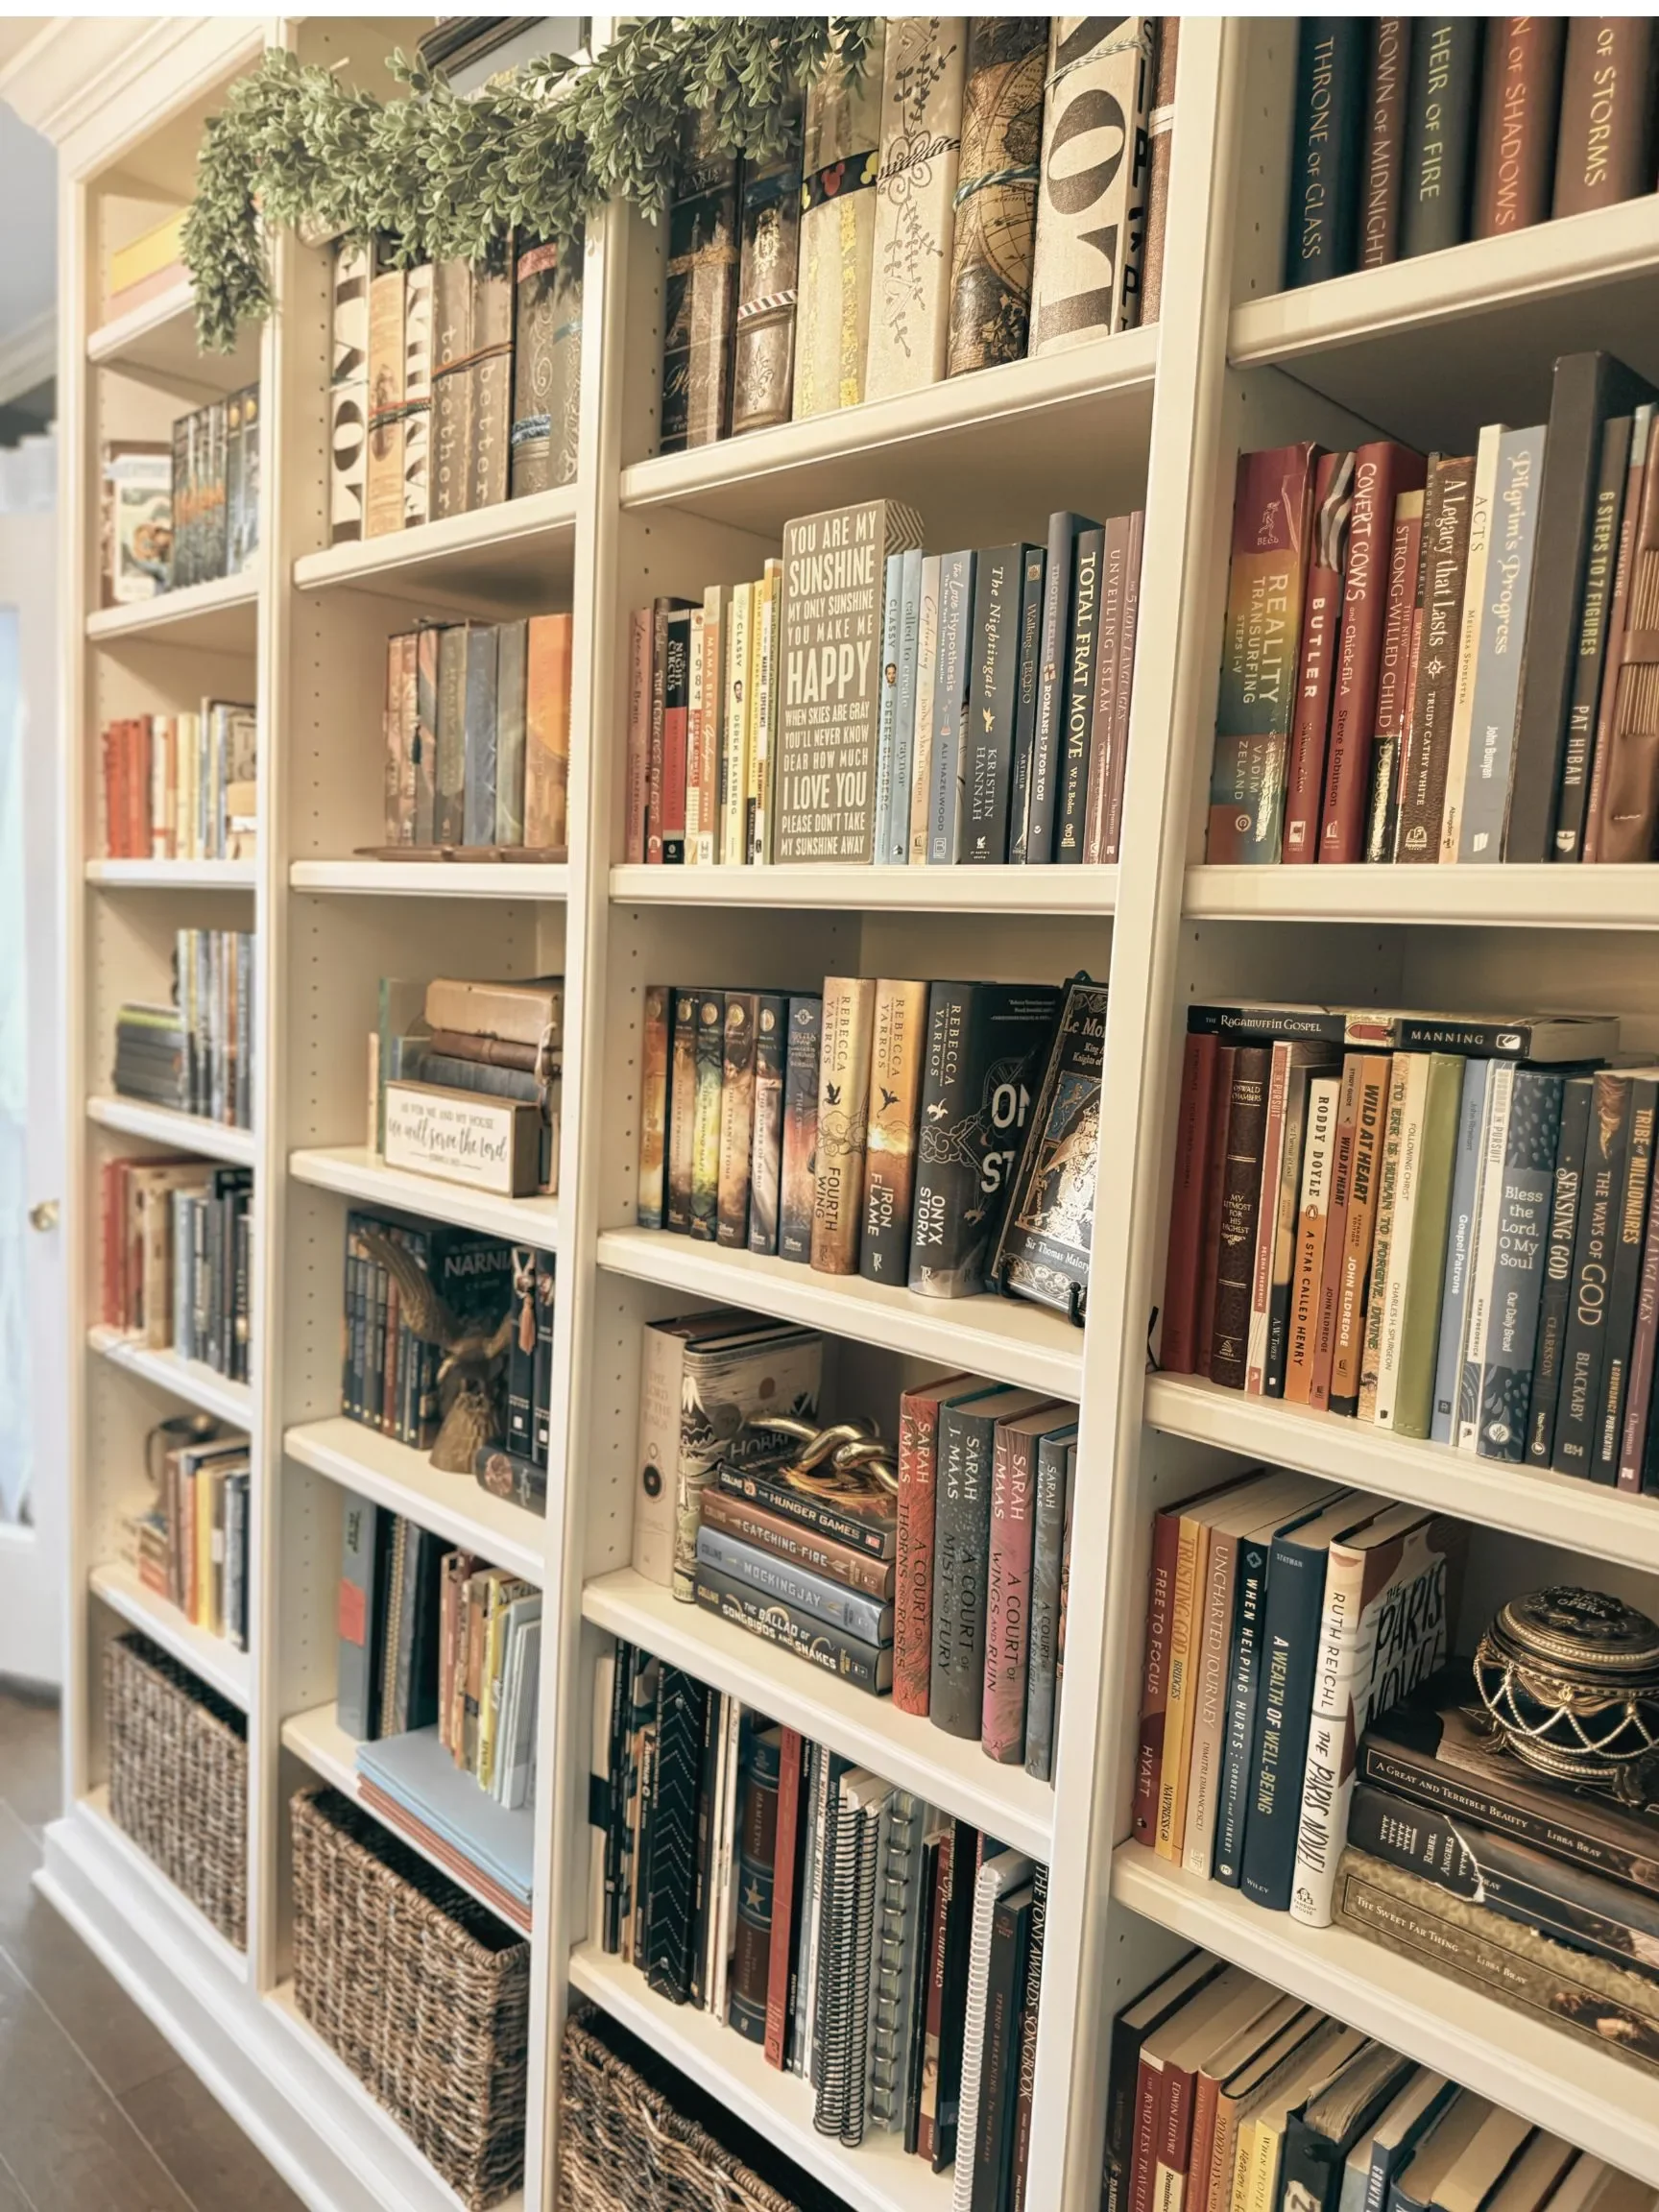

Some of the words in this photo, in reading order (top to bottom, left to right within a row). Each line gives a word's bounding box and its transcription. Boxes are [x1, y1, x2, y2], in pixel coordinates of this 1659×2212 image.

[1428, 27, 1451, 93] HEIR
[1307, 36, 1334, 143] THRONE
[1496, 84, 1527, 226] SHADOWS
[1584, 70, 1616, 187] STORMS
[1420, 145, 1443, 202] FIRE
[1303, 185, 1324, 259] GLASS
[1365, 139, 1390, 265] MIDNIGHT
[1350, 462, 1377, 540] COVERT
[1433, 497, 1466, 554] Legacy
[1472, 495, 1487, 552] ACTS
[791, 523, 815, 555] YOU
[823, 517, 849, 548] ARE
[856, 511, 877, 541] MY
[1593, 505, 1614, 553] STEPS
[789, 545, 875, 597] SUNSHINE
[991, 566, 1003, 597] The
[1076, 552, 1095, 626] TOTAL
[1345, 542, 1367, 601] COWS
[1590, 558, 1607, 575] TO
[787, 602, 801, 623] MY
[804, 597, 824, 618] ONLY
[829, 589, 874, 615] SUNSHINE
[1104, 550, 1120, 648] UNVEILING
[1381, 525, 1409, 669] STRONG-WILLED
[1581, 592, 1602, 655] FIGURES
[787, 625, 809, 645] YOU
[817, 618, 849, 640] MAKE
[857, 614, 873, 635] ME
[982, 604, 1001, 697] Nightingale
[1242, 576, 1265, 703] TRANSURFING
[1258, 573, 1288, 703] REALITY
[1303, 598, 1325, 699] BUTLER
[786, 640, 872, 706] HAPPY
[1073, 632, 1092, 686] FRAT
[785, 709, 806, 727] WHEN
[808, 707, 830, 724] SKIES
[831, 705, 847, 721] ARE
[849, 702, 870, 719] GRAY
[1041, 685, 1052, 735] ROMANS
[1069, 693, 1088, 759] MOVE
[1337, 709, 1348, 745] Steve
[1379, 673, 1396, 729] CHILD
[1426, 691, 1435, 728] TRUDY
[1571, 707, 1590, 732] PAT
[784, 730, 810, 750] YOU'LL
[814, 727, 839, 746] NEVER
[844, 725, 868, 744] KNOW
[784, 754, 808, 772] DEAR
[813, 751, 834, 769] HOW
[839, 749, 868, 766] MUCH
[1421, 731, 1431, 768] CATHY
[1565, 738, 1585, 784] HIBAN
[793, 775, 830, 809] LOVE
[836, 772, 866, 806] YOU
[973, 746, 984, 821] HANNAH
[985, 749, 997, 818] KRISTIN
[1235, 740, 1248, 800] ZELAND
[1250, 745, 1262, 792] VADIM
[1329, 748, 1343, 806] Robinson
[1417, 768, 1428, 805] WHITE
[781, 841, 793, 856] MY
[795, 838, 837, 854] SUNSHINE
[840, 836, 864, 854] AWAY
[782, 815, 811, 833] PLEASE
[815, 814, 841, 830] DON'T
[843, 812, 865, 830] TAKE
[824, 1000, 834, 1064] YARROS
[837, 997, 850, 1072] REBECCA
[878, 1004, 889, 1068] YARROS
[892, 999, 904, 1077] REBECCA
[930, 1010, 944, 1077] YARROS
[945, 1005, 961, 1086] REBECCA
[1411, 1031, 1484, 1045] MANNING
[1314, 1096, 1329, 1142] RODDY
[1362, 1084, 1379, 1126] WILD
[1634, 1109, 1652, 1145] TRIBE
[1360, 1128, 1373, 1149] AT
[815, 1176, 830, 1218] WING
[826, 1166, 841, 1231] FOURTH
[1310, 1151, 1323, 1197] DOYLE
[1334, 1173, 1345, 1207] HEART
[1353, 1152, 1371, 1205] HEART
[1505, 1187, 1544, 1202] Bless
[1596, 1171, 1610, 1196] THE
[1623, 1157, 1648, 1244] MILLIONAIRES
[868, 1172, 882, 1237] FLAME
[880, 1187, 894, 1228] IRON
[917, 1188, 930, 1246] STORM
[927, 1195, 945, 1244] ONYX
[1509, 1206, 1533, 1218] the
[1550, 1167, 1578, 1245] SENSING
[1590, 1201, 1609, 1238] WAYS
[445, 1251, 512, 1279] NARNI
[1303, 1243, 1313, 1272] STAR
[1347, 1257, 1357, 1287] JOHN
[1452, 1252, 1465, 1294] Patrons
[1500, 1254, 1533, 1269] Soul
[1514, 1240, 1538, 1254] My
[1589, 1239, 1603, 1259] OF
[1299, 1278, 1310, 1320] CALLED
[1340, 1290, 1353, 1347] ELDREDGE
[1578, 1264, 1606, 1326] GOD
[1293, 1325, 1306, 1366] HENRY
[1570, 1352, 1590, 1421] BLACKABY
[917, 1421, 932, 1483] SARAH
[965, 1436, 979, 1501] SARAH
[1011, 1455, 1026, 1521] SARAH
[770, 1494, 815, 1520] HUNGER
[819, 1514, 860, 1539] GAMES
[899, 1503, 909, 1577] THORNS
[802, 1545, 829, 1568] FIRE
[1174, 1538, 1194, 1617] TRUSTING
[959, 1569, 976, 1652] COURT
[1154, 1568, 1167, 1607] FREE
[1206, 1546, 1229, 1649] UNCHARTED
[1244, 1579, 1258, 1620] WHEN
[758, 1608, 797, 1635] BALLAD
[895, 1606, 906, 1671] ROSES
[1003, 1589, 1021, 1663] COURT
[1152, 1614, 1165, 1634] TO
[1329, 1592, 1345, 1640] RUTH
[794, 1641, 836, 1670] SNAKES
[985, 1642, 998, 1694] RUIN
[1148, 1640, 1162, 1695] FOCUS
[1238, 1629, 1253, 1694] HELPING
[1265, 1650, 1289, 1709] WEALTH
[1321, 1646, 1340, 1707] REICHL
[1266, 1713, 1281, 1727] OF
[1140, 1744, 1152, 1796] HYATT
[1258, 1730, 1279, 1814] WELL-BEING
[1305, 1758, 1334, 1815] PARIS
